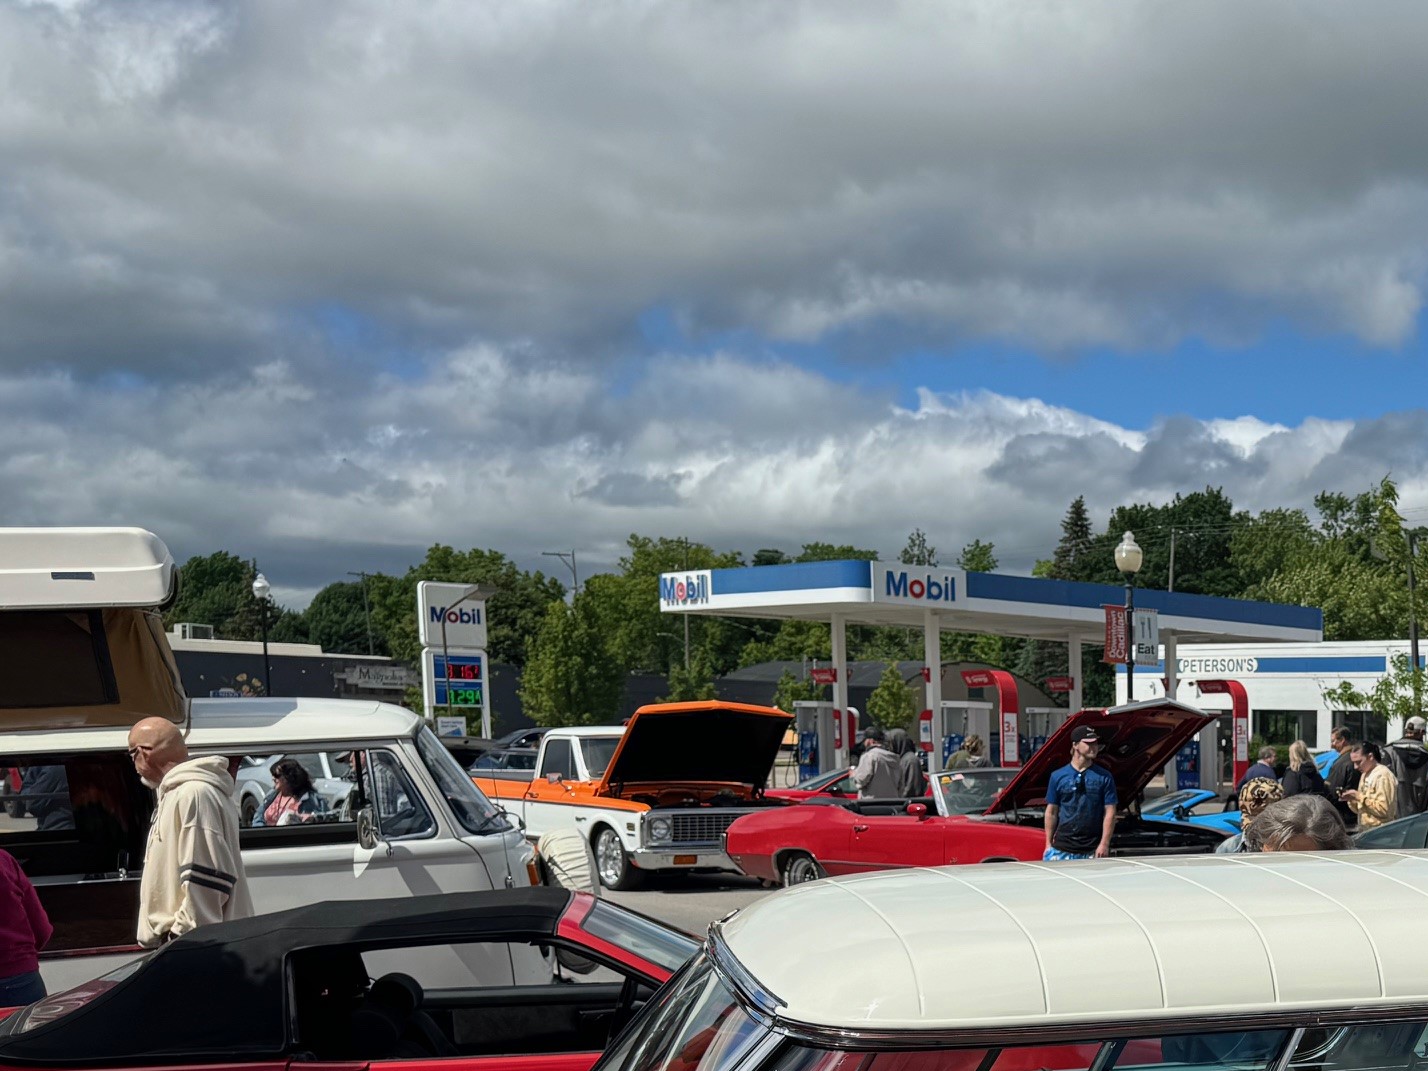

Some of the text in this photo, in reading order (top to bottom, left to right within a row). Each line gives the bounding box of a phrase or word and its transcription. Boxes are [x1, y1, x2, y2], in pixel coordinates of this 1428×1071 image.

[662, 574, 707, 602] Mobil
[886, 570, 956, 602] Mobil
[430, 606, 481, 625] Mobil
[1109, 610, 1117, 658] Downtown
[1116, 611, 1126, 659] Cadillac
[1138, 643, 1155, 655] Eat
[1182, 658, 1254, 673] PETERSON'S
